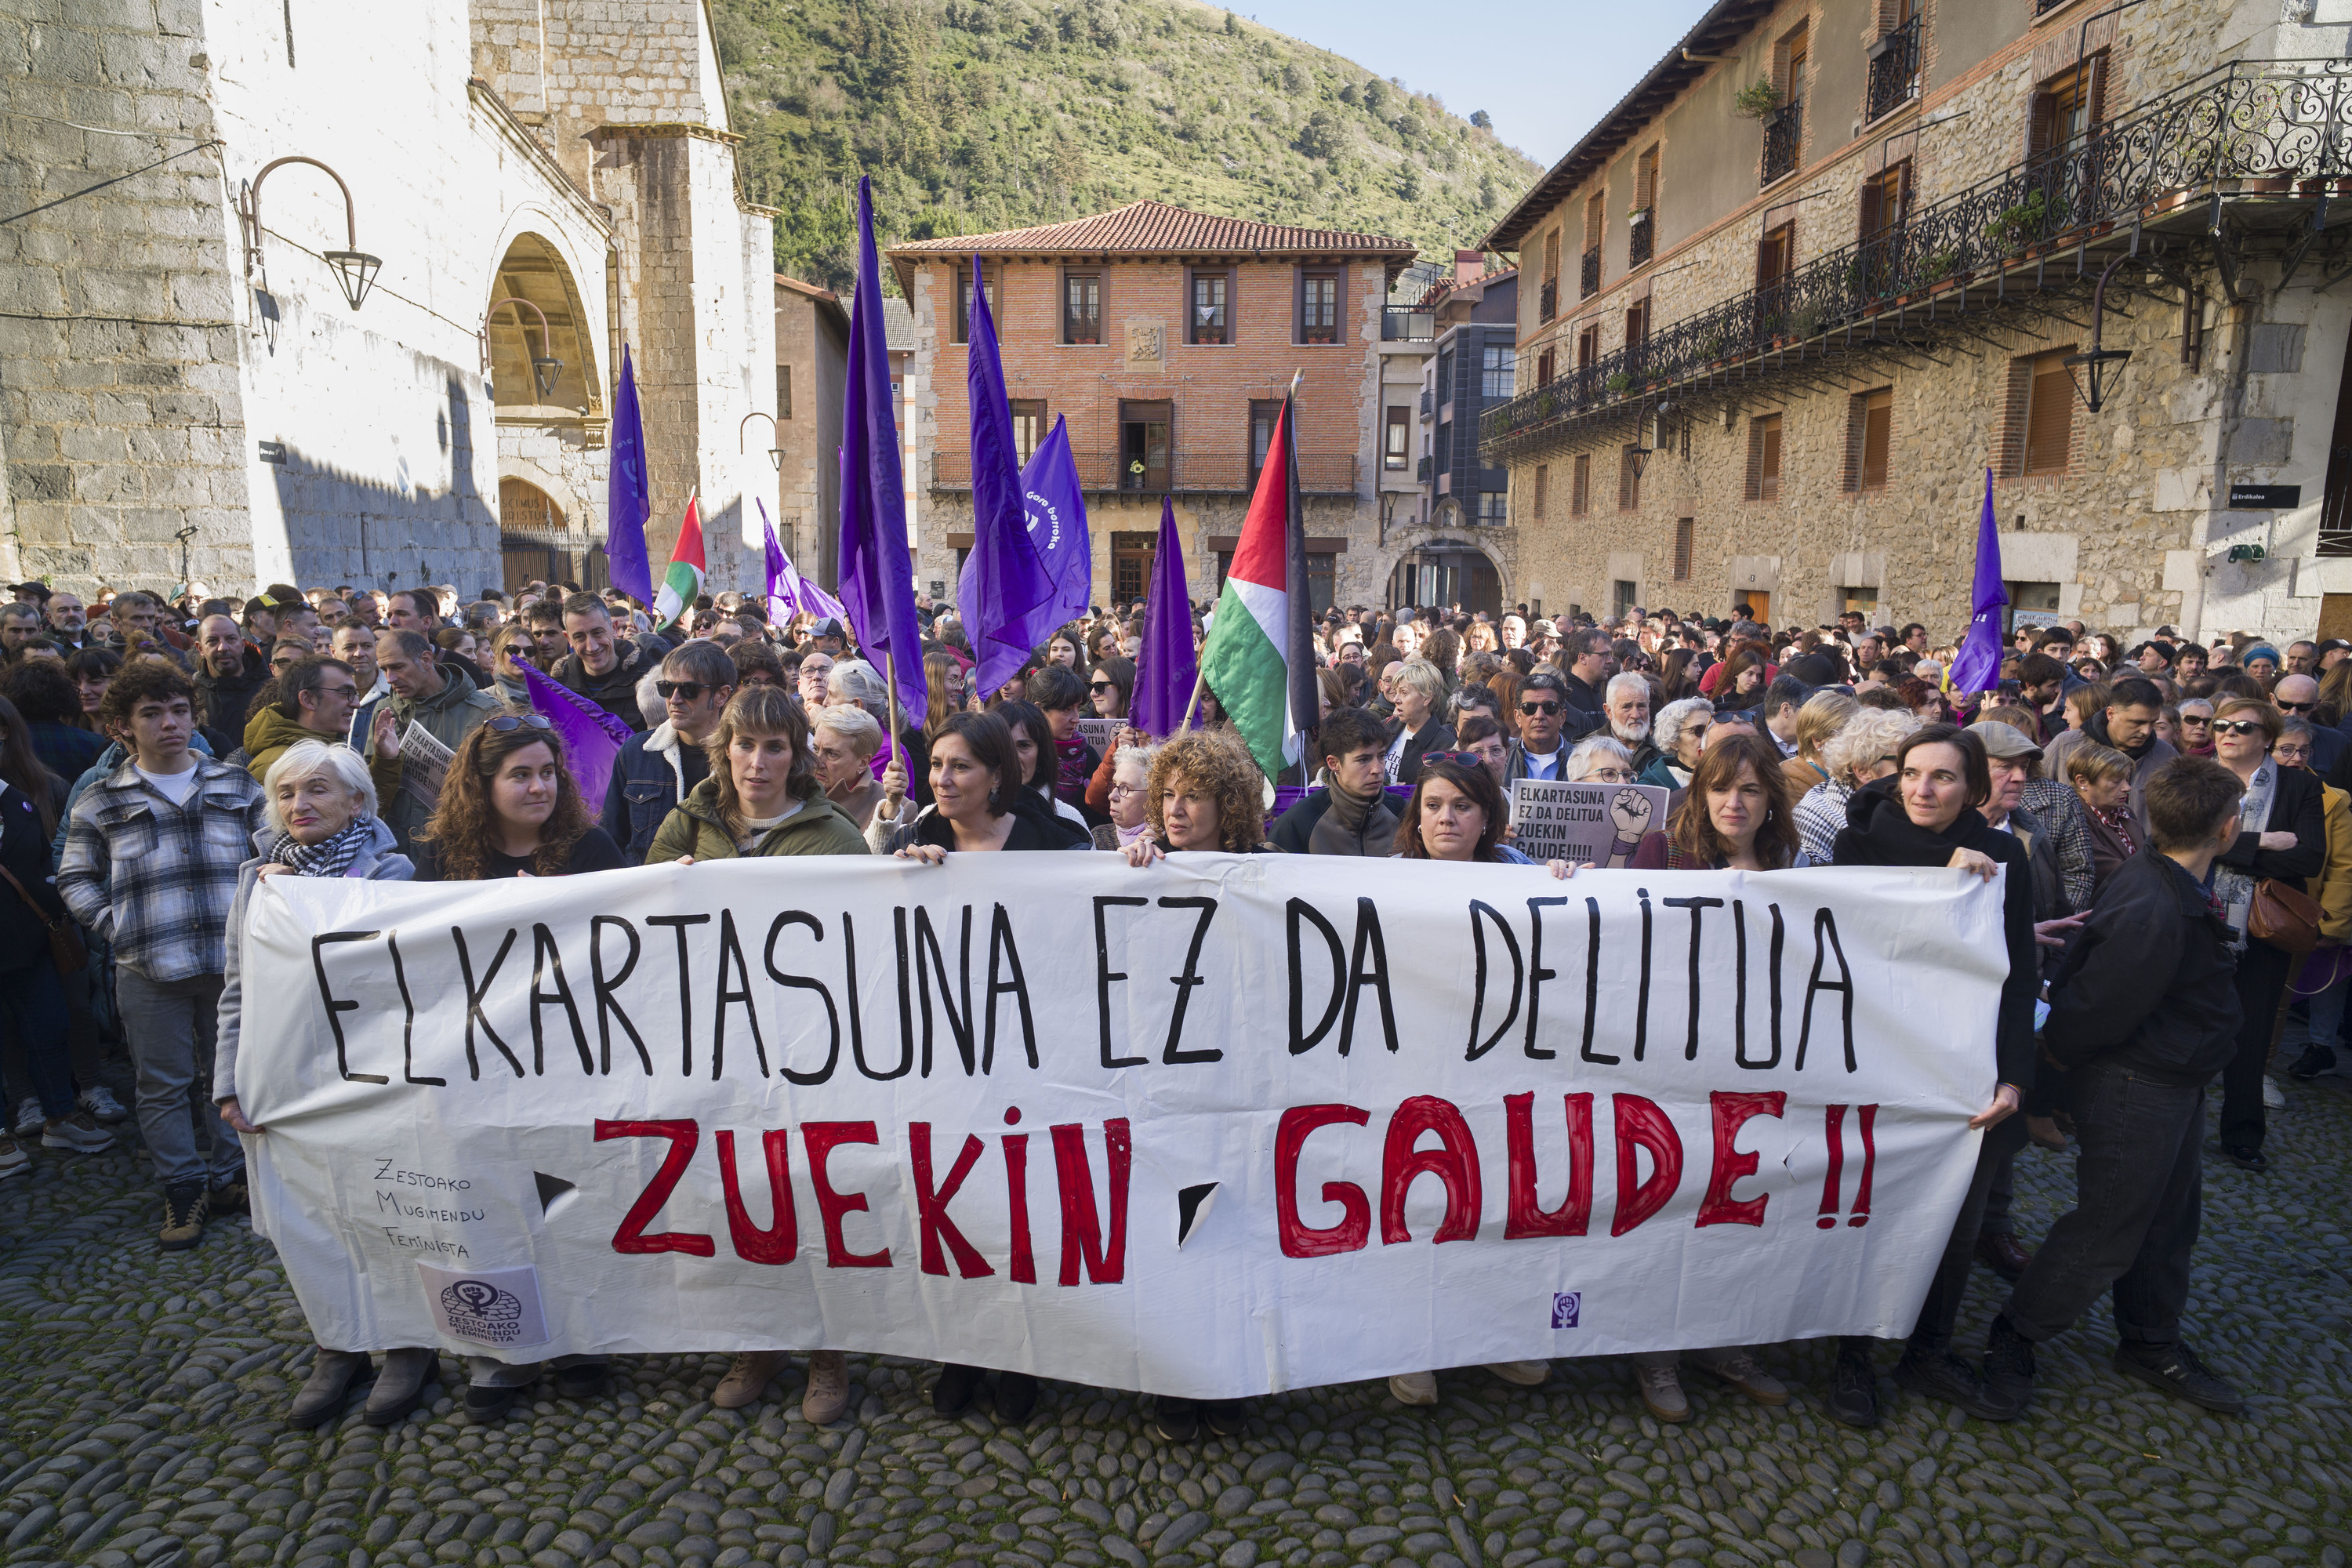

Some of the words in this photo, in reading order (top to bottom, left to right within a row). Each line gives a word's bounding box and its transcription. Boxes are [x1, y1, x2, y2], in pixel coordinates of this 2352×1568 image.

[500, 510, 548, 521] HRISTUM
[1025, 491, 1049, 507] Gora
[1047, 506, 1061, 550] borroka
[410, 729, 452, 764] ELKARTASUN
[404, 739, 414, 751] EZ
[412, 746, 422, 758] DA
[423, 754, 448, 775] DELITU
[404, 754, 430, 775] UEKIN
[404, 768, 441, 796] AUDE!!!!!
[1520, 786, 1605, 805] ELKARTASUNA
[1519, 805, 1532, 818] EZ
[1537, 806, 1552, 820] DA
[1556, 807, 1603, 822] DELITUA
[1517, 822, 1566, 840] ZUEKIN
[313, 902, 1039, 1087] ELKARTASUNA
[1093, 896, 1224, 1069] EZ
[1285, 896, 1399, 1058] DA
[448, 1316, 519, 1330] ZESTOAKO
[448, 1323, 521, 1337] MUGIMENDU
[456, 1329, 515, 1343] FEMINISTA
